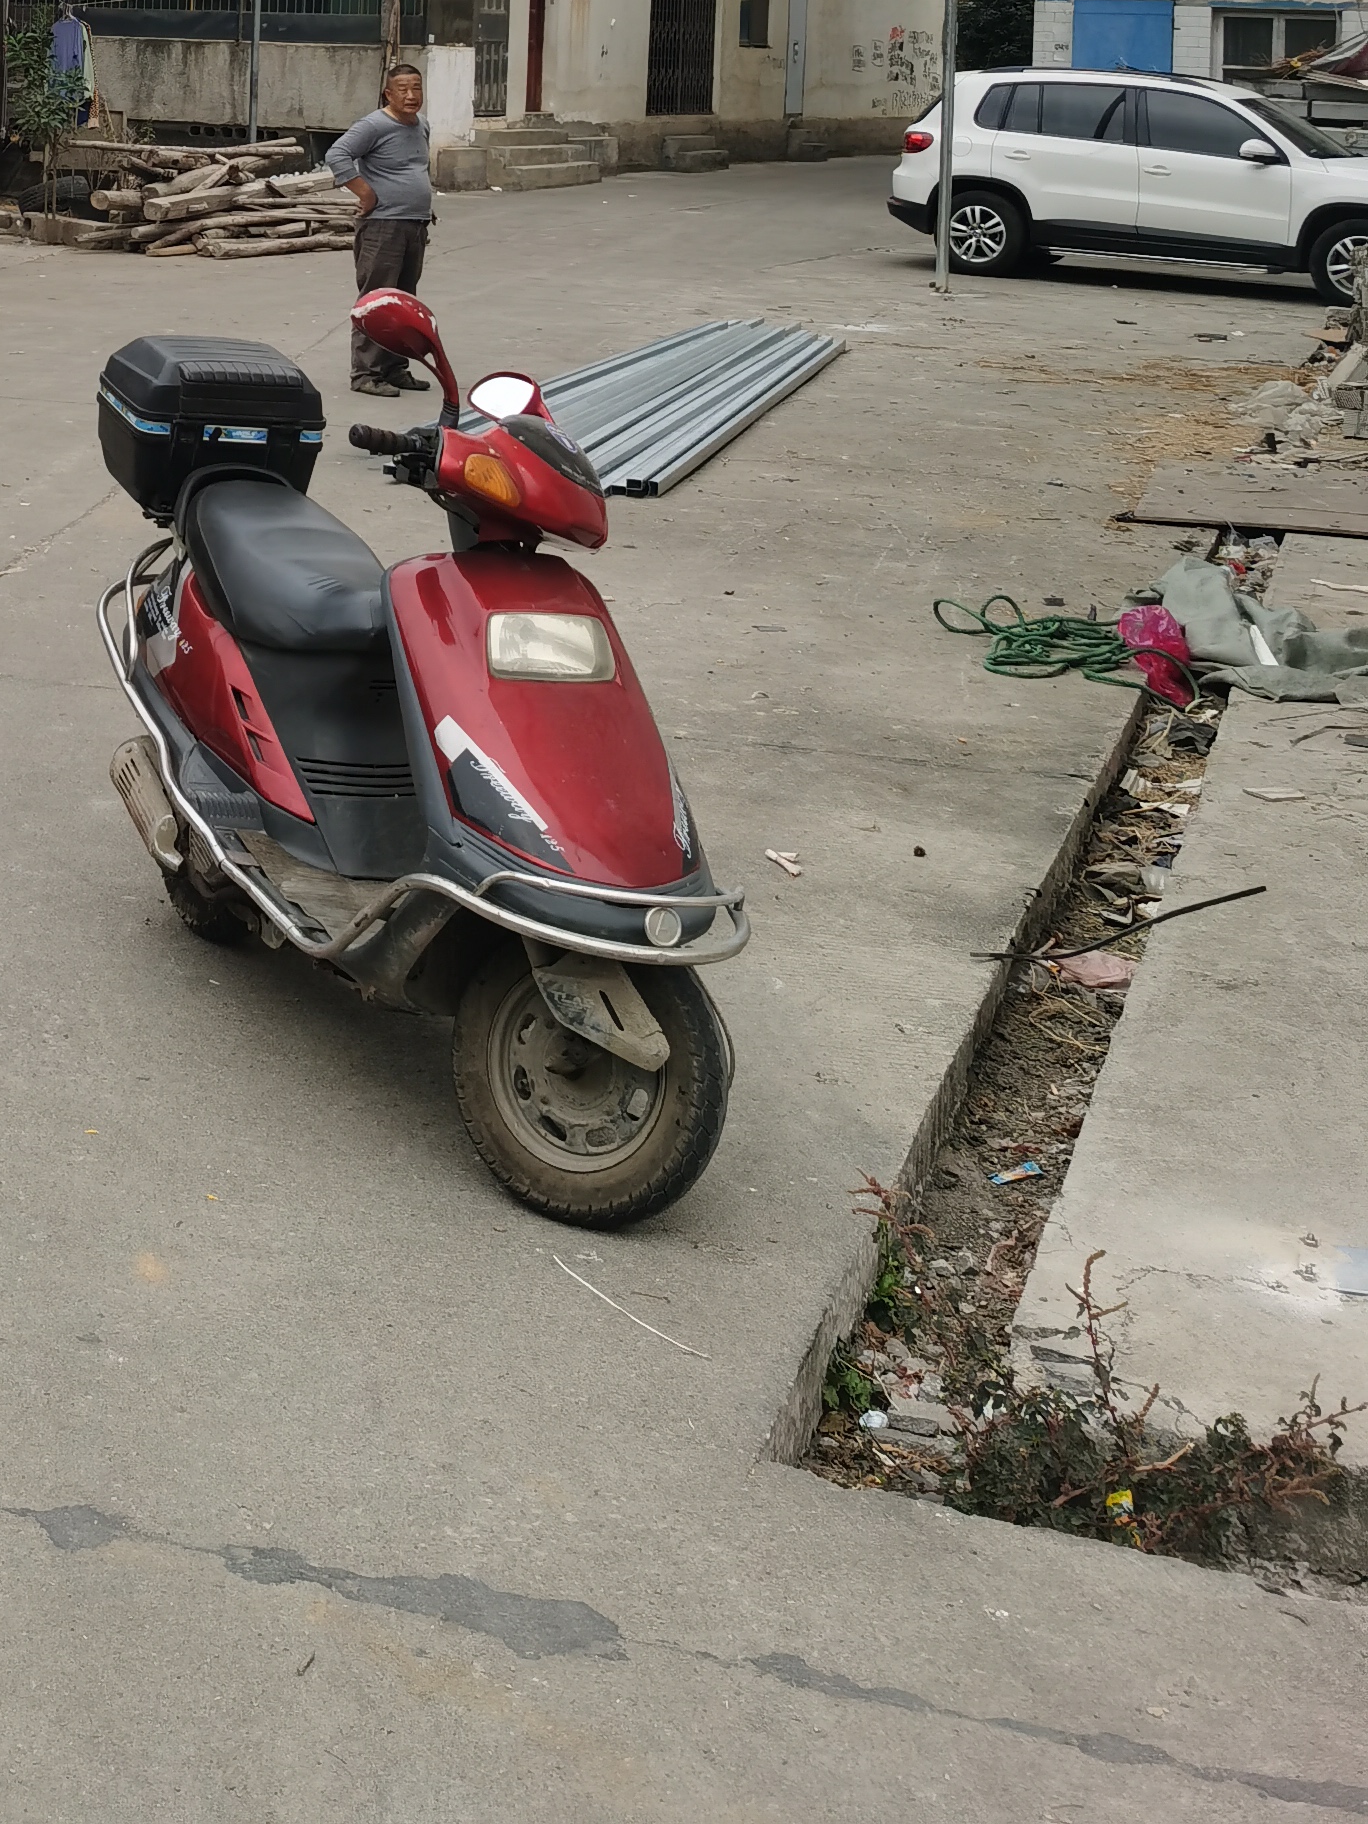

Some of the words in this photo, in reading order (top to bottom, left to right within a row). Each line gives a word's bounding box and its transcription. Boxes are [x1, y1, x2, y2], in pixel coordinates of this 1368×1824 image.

[157, 586, 182, 641] Freeway
[470, 757, 533, 824] Freeway
[540, 832, 565, 853] 125
